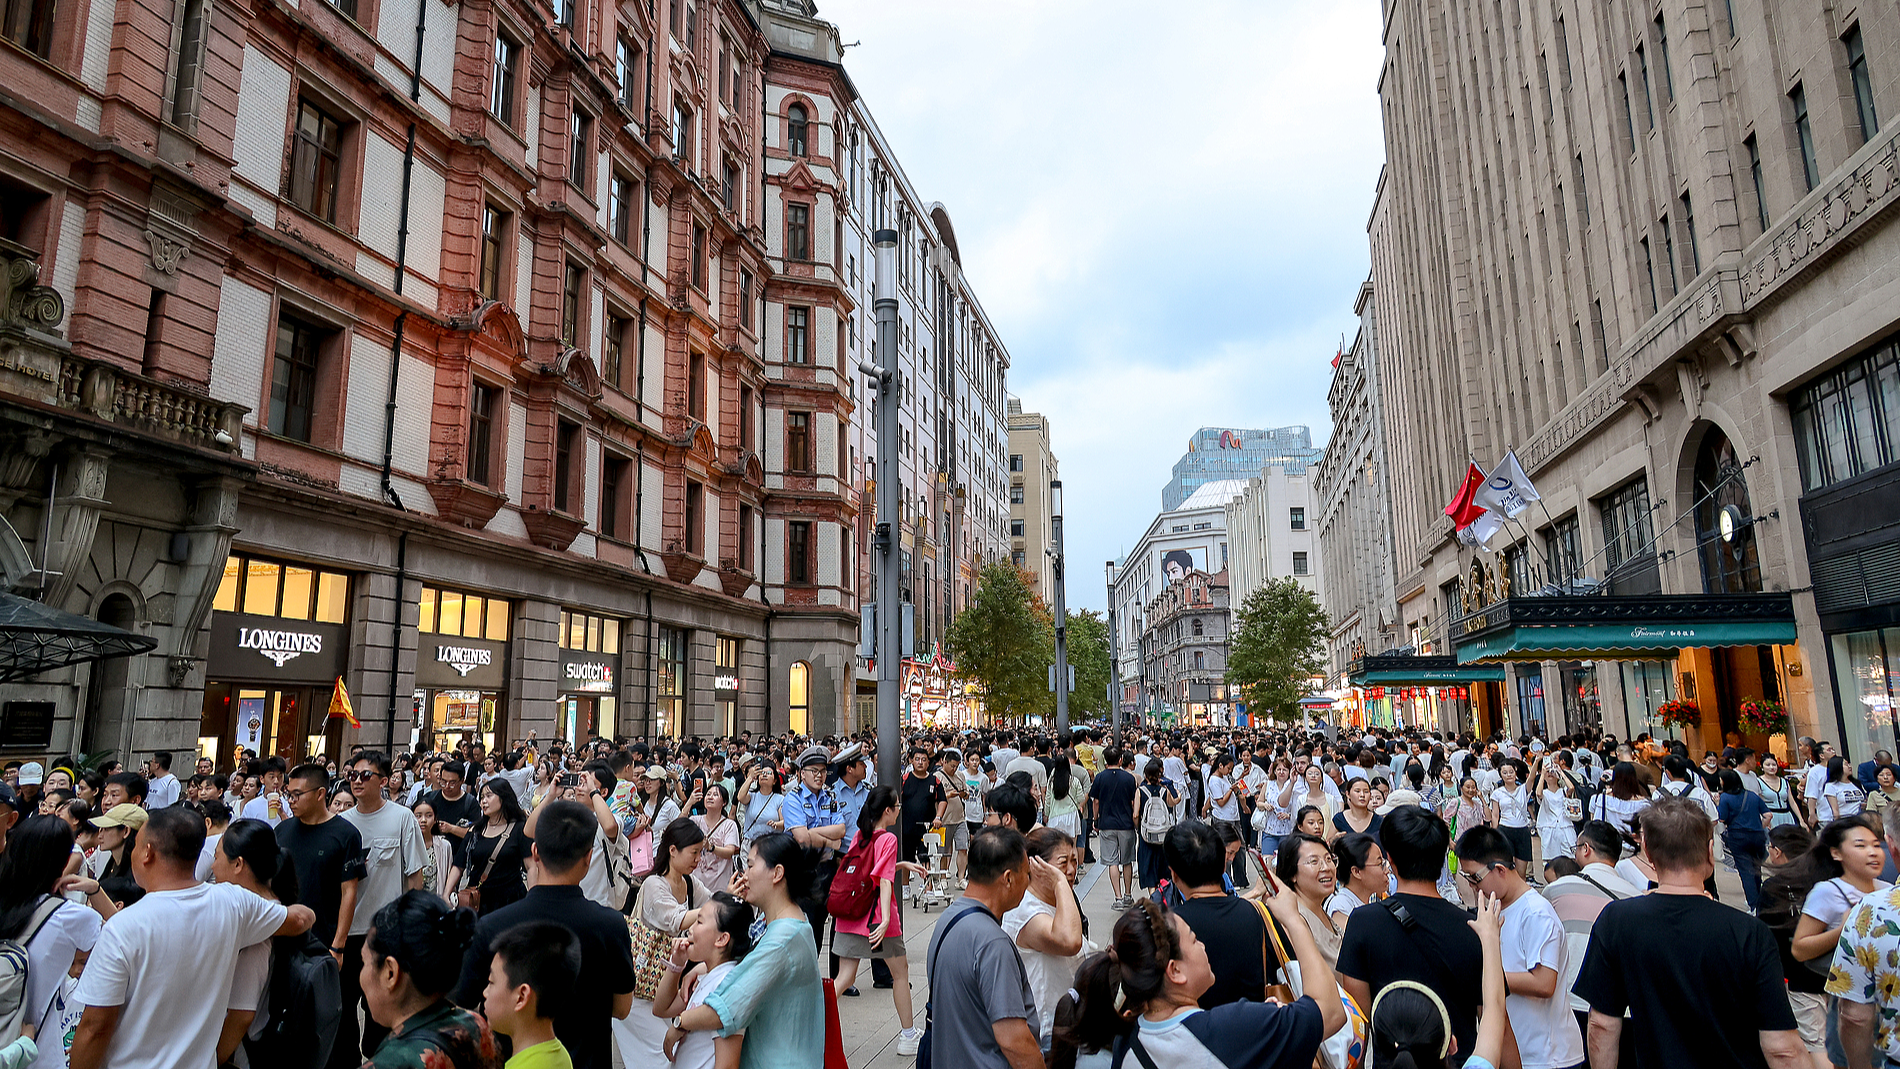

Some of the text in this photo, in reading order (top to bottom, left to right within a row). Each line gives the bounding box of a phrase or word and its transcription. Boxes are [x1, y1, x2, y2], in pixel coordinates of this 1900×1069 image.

[16, 362, 56, 382] HOTEL
[238, 627, 322, 654] LONGINES
[437, 645, 492, 666] LONGINES
[566, 661, 605, 681] swatch
[715, 674, 735, 690] watch
